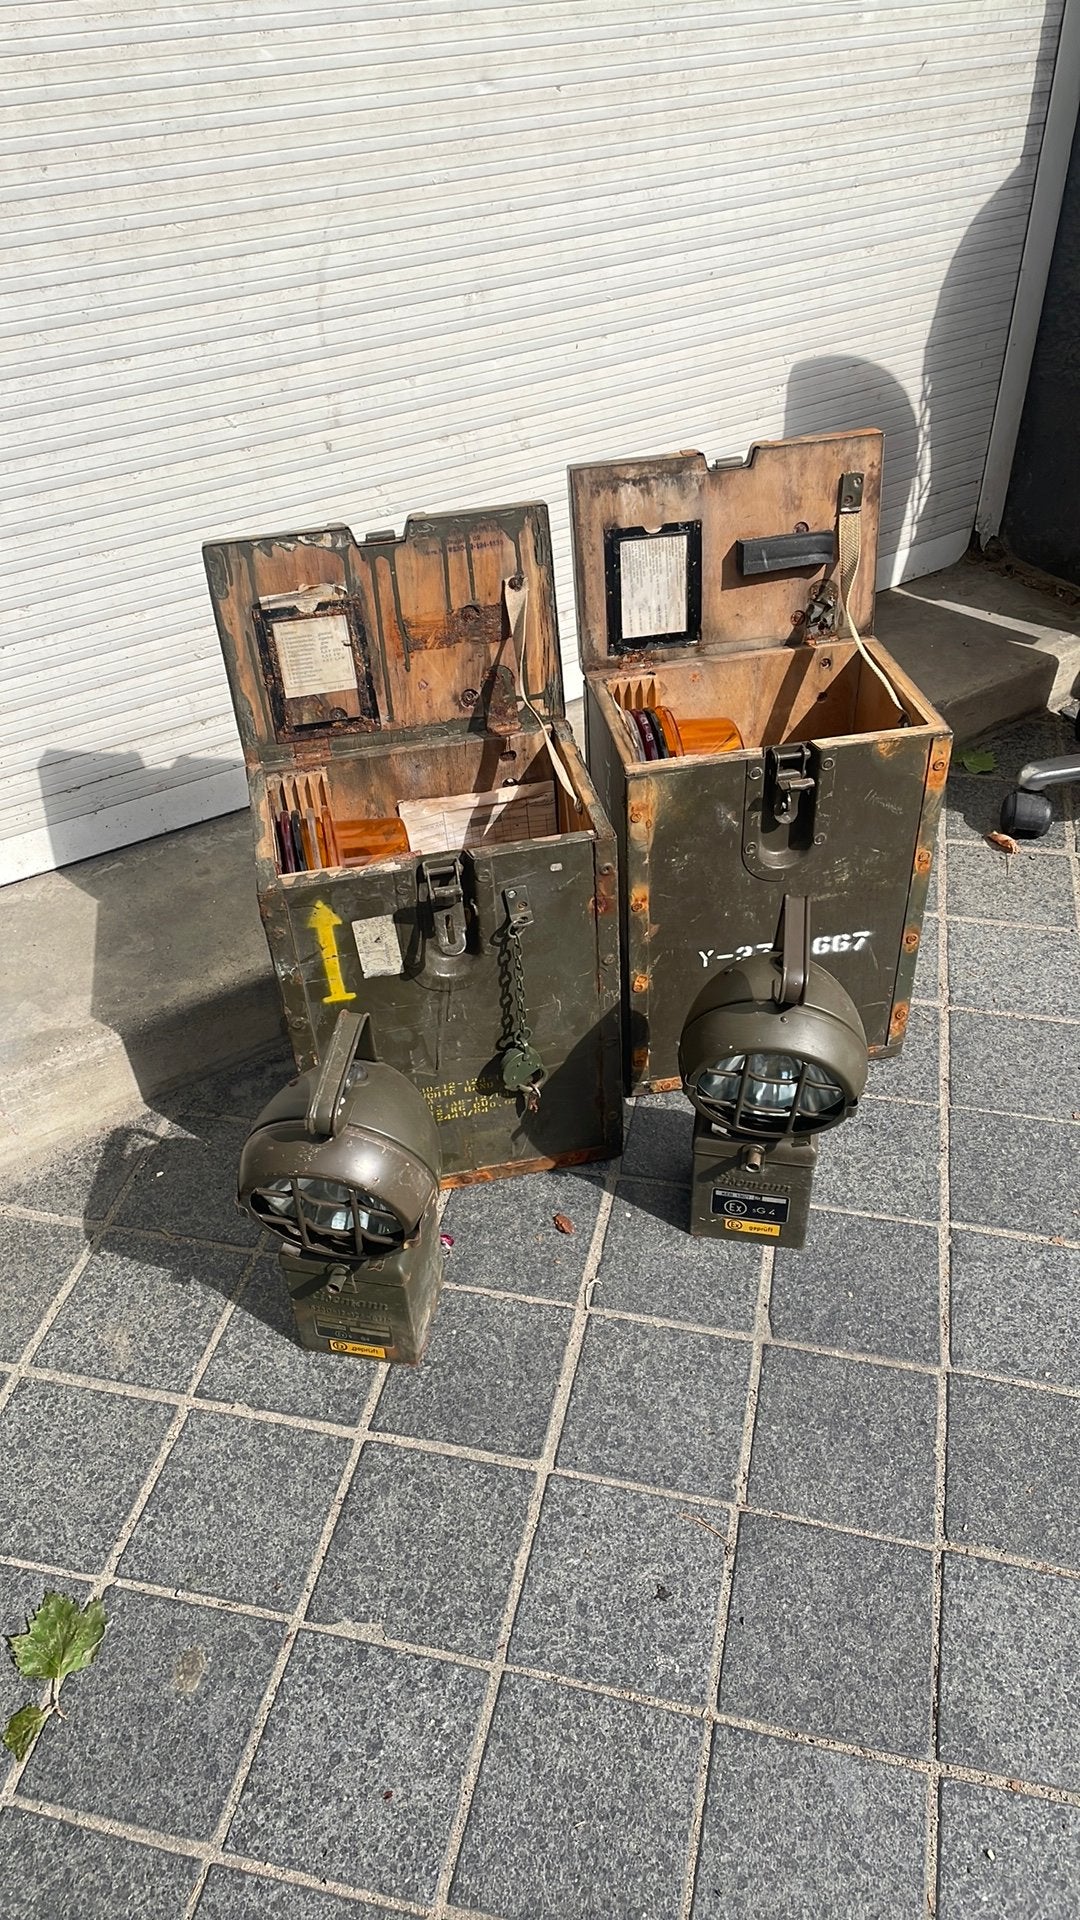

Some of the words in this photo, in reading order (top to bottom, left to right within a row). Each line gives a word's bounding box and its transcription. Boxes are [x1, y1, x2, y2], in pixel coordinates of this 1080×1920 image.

[812, 931, 872, 955] 667
[727, 1202, 744, 1214] Ex
[748, 1225, 774, 1234] geprüft
